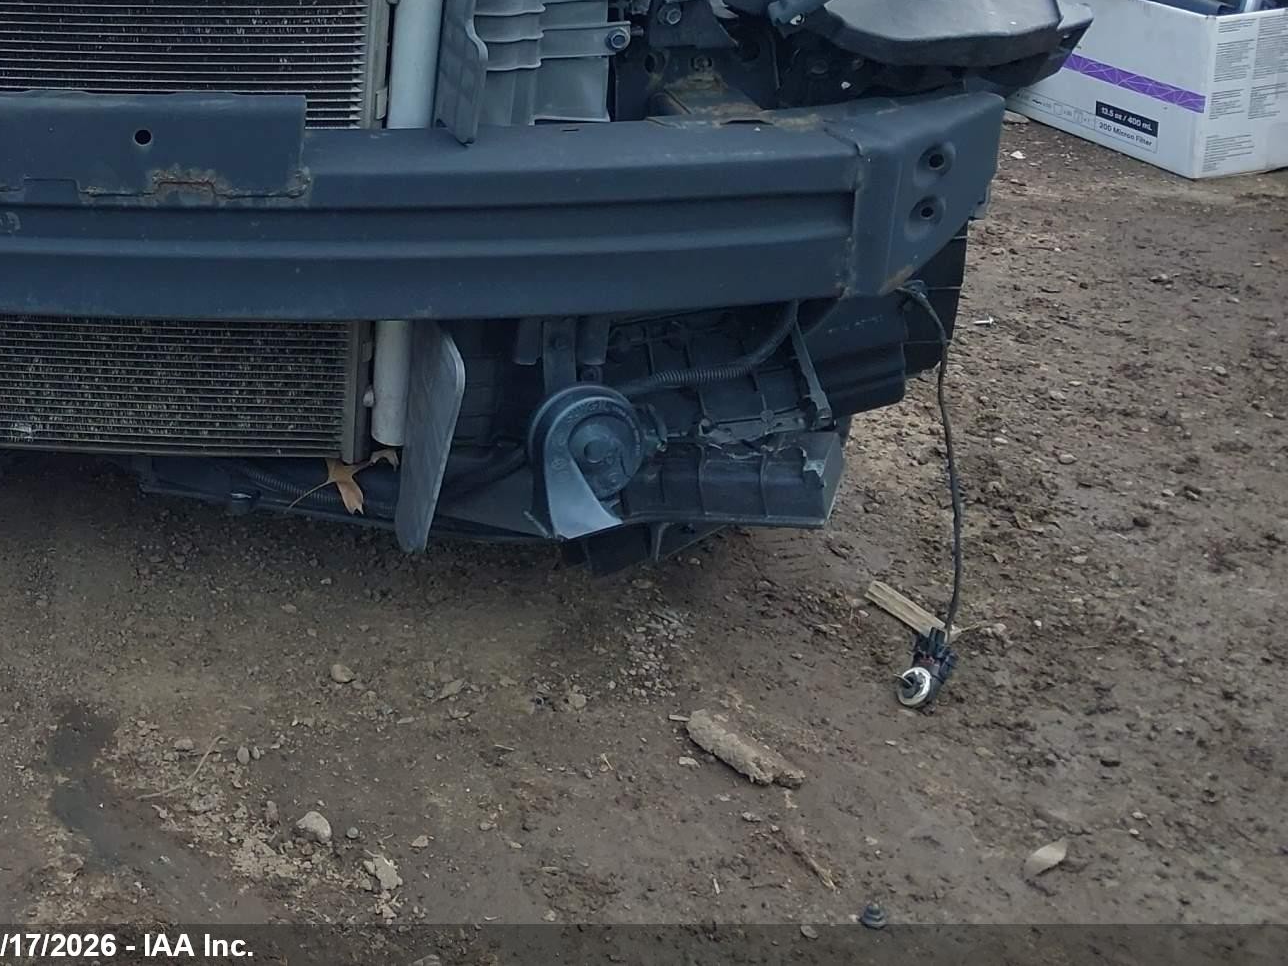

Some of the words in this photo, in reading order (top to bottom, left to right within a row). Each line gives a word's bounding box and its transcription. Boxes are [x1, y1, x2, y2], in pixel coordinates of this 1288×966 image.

[1098, 121, 1112, 132] 200
[1113, 126, 1135, 140] Micron
[1135, 135, 1153, 146] Filter
[1127, 116, 1142, 127] 400
[1142, 122, 1153, 131] mL
